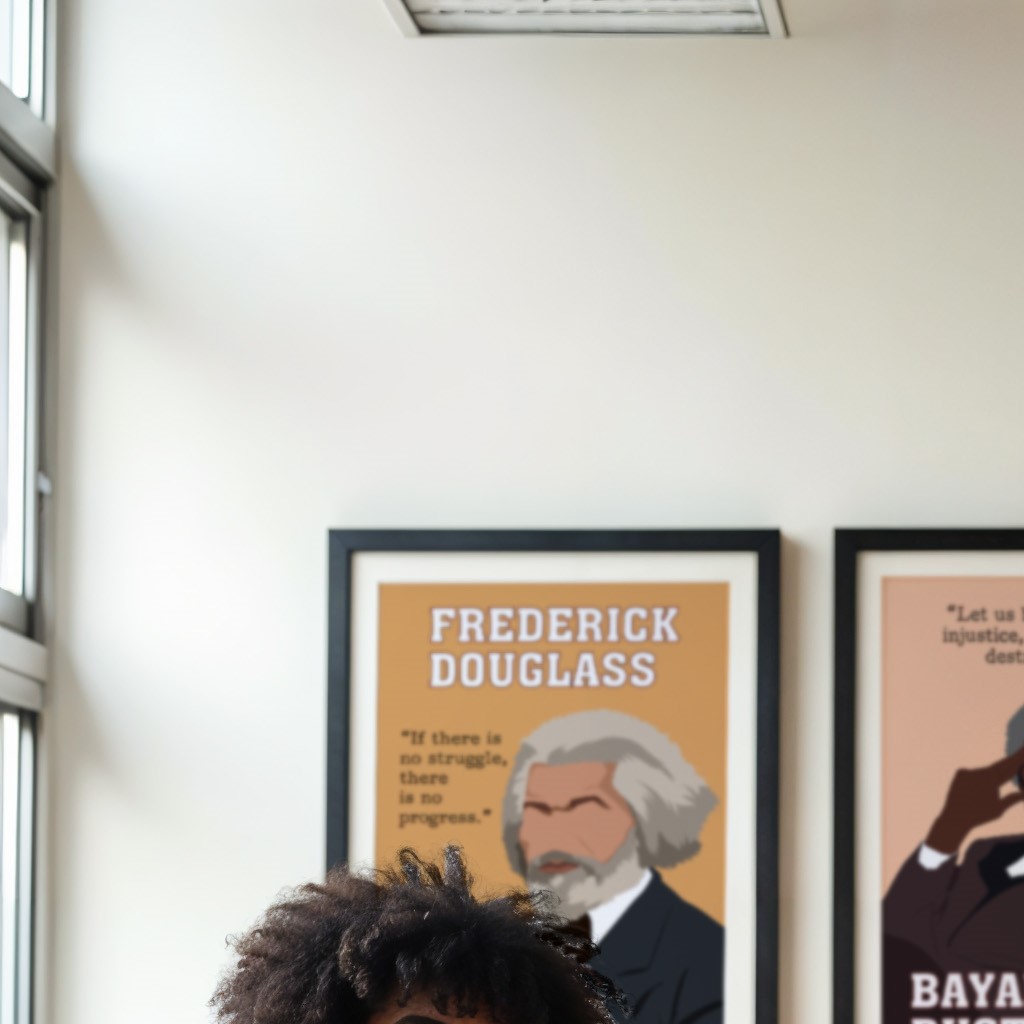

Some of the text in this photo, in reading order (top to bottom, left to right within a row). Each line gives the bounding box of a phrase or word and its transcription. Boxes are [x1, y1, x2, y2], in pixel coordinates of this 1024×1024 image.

[431, 606, 680, 642] FREDERICK
[994, 609, 1015, 622] us
[942, 627, 1024, 647] injustice,
[431, 652, 656, 688] DOUGLASS
[431, 731, 480, 746] there
[486, 731, 502, 746] is
[400, 750, 508, 770] no struggle,
[400, 771, 448, 786] there
[400, 790, 443, 805] is no
